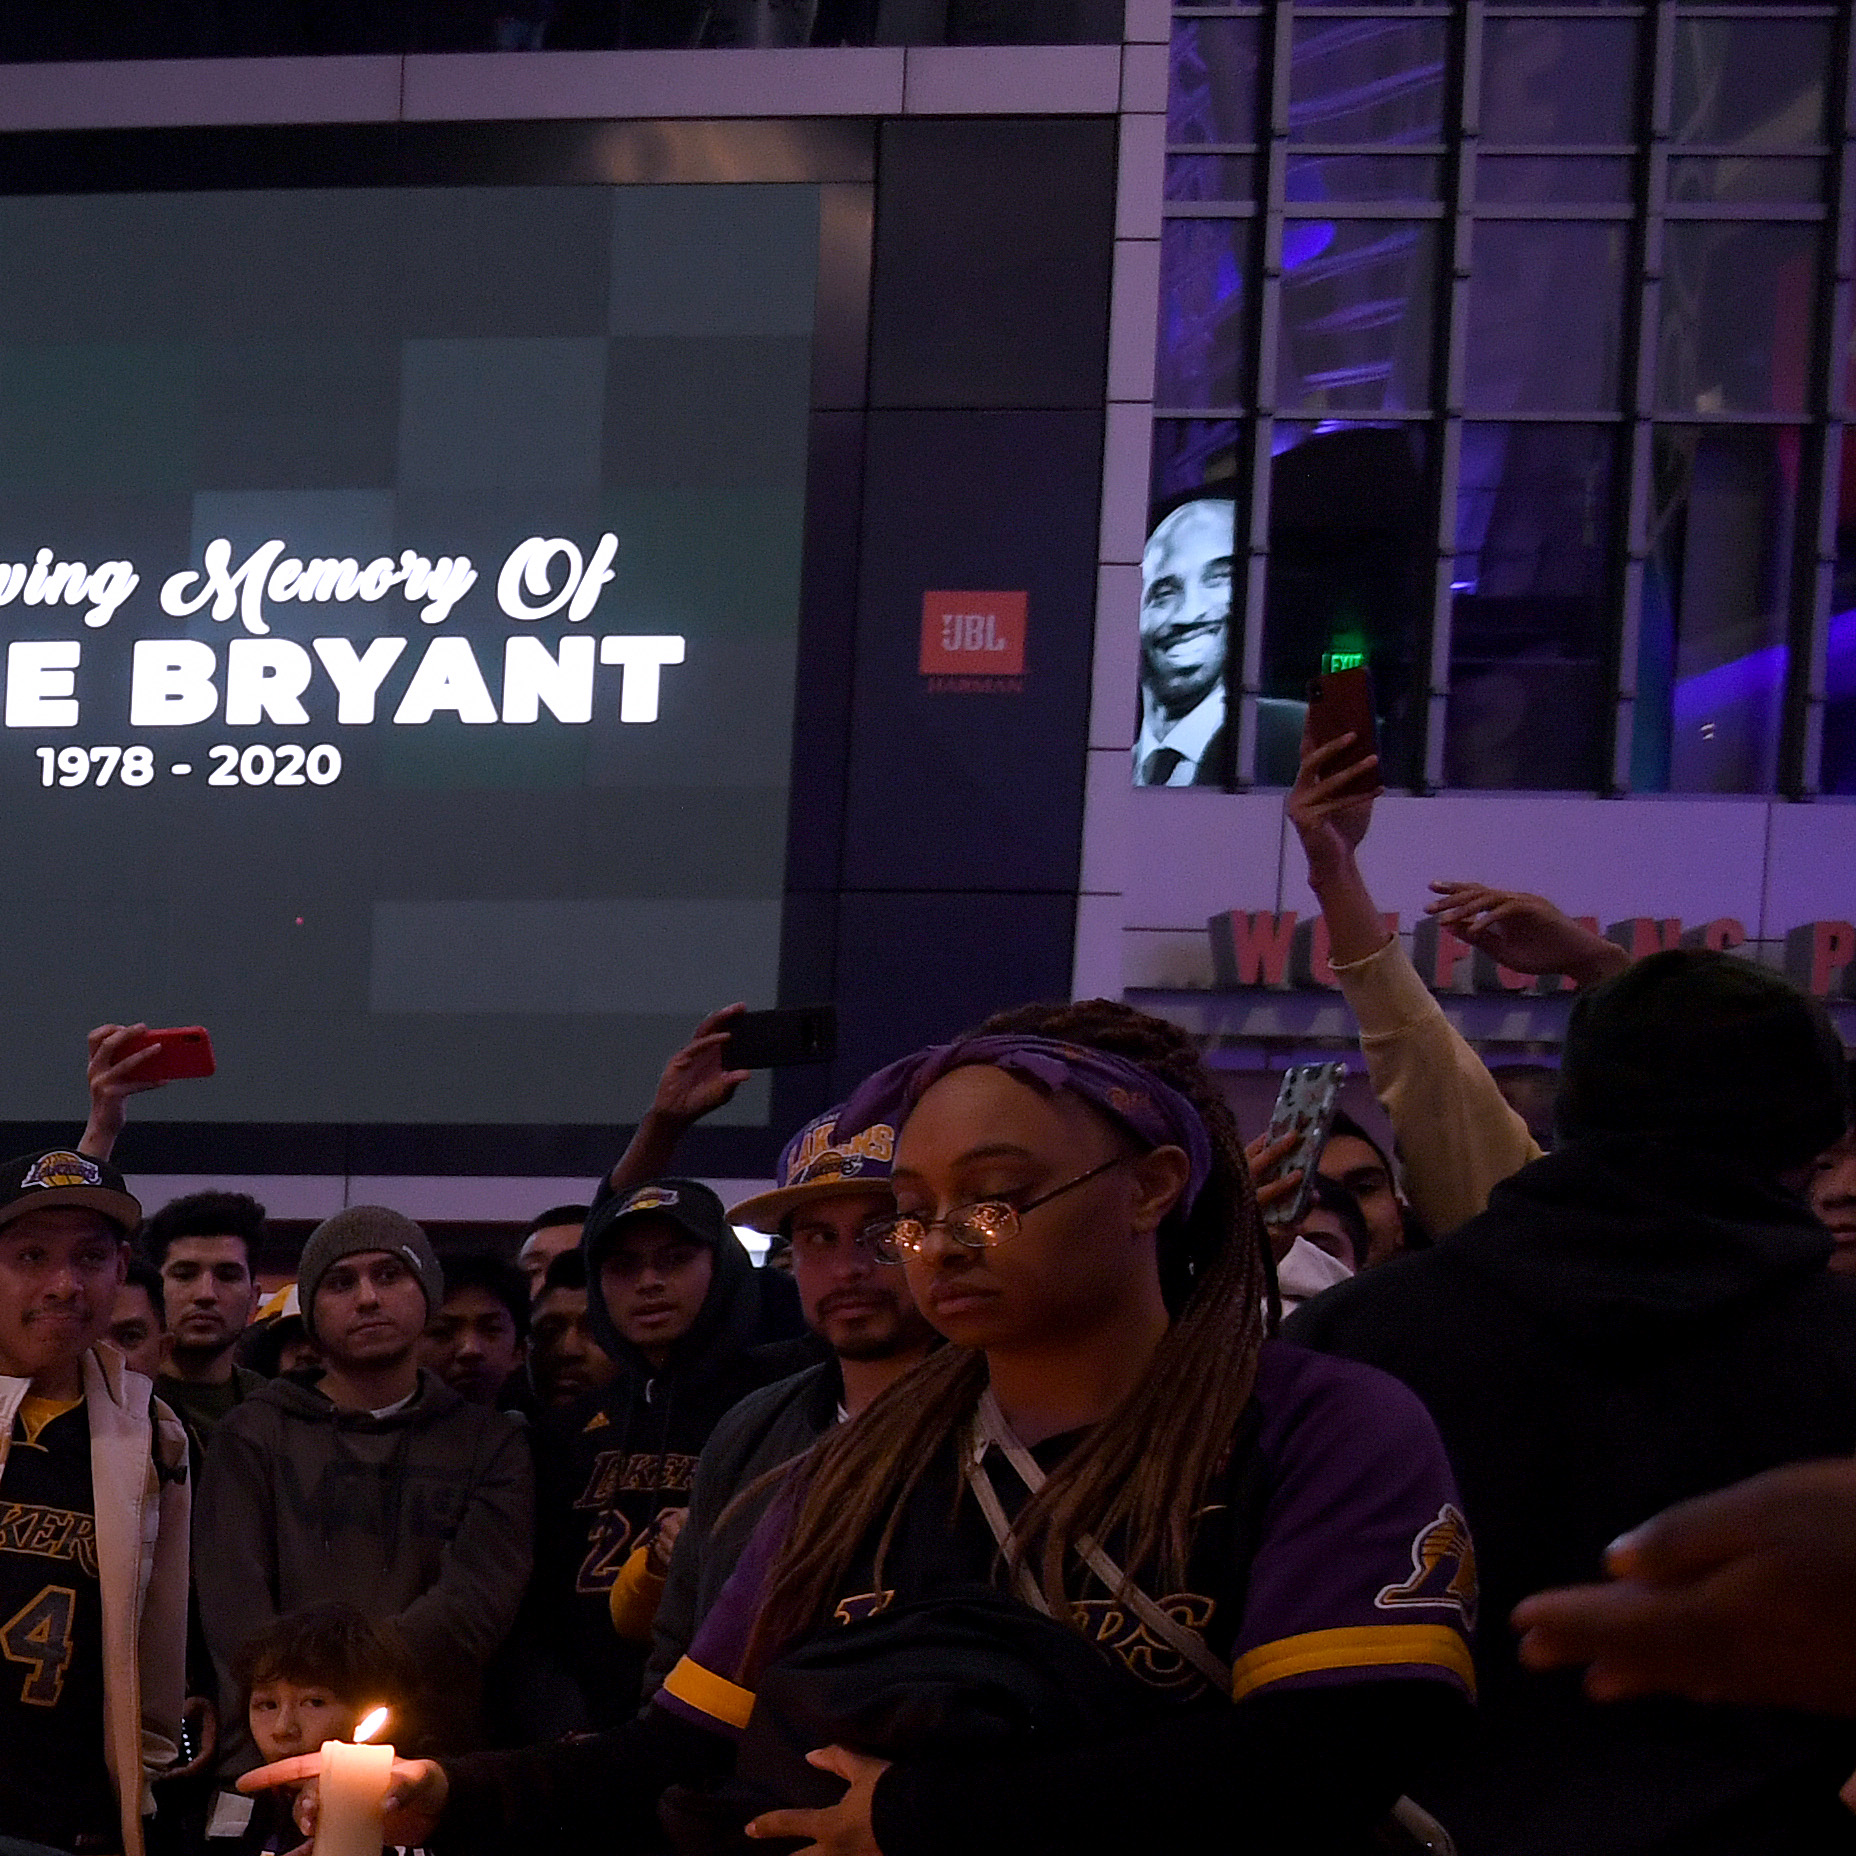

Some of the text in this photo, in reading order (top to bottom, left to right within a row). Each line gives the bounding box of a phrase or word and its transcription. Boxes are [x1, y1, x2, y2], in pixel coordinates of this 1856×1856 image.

[159, 539, 478, 635] Memory
[496, 532, 618, 623] Of
[942, 614, 1006, 652] JBL
[131, 635, 686, 728] BRYANT
[1331, 654, 1365, 674] EXIT
[36, 744, 341, 787] 1978 - 2020
[572, 1450, 701, 1510] LAKER
